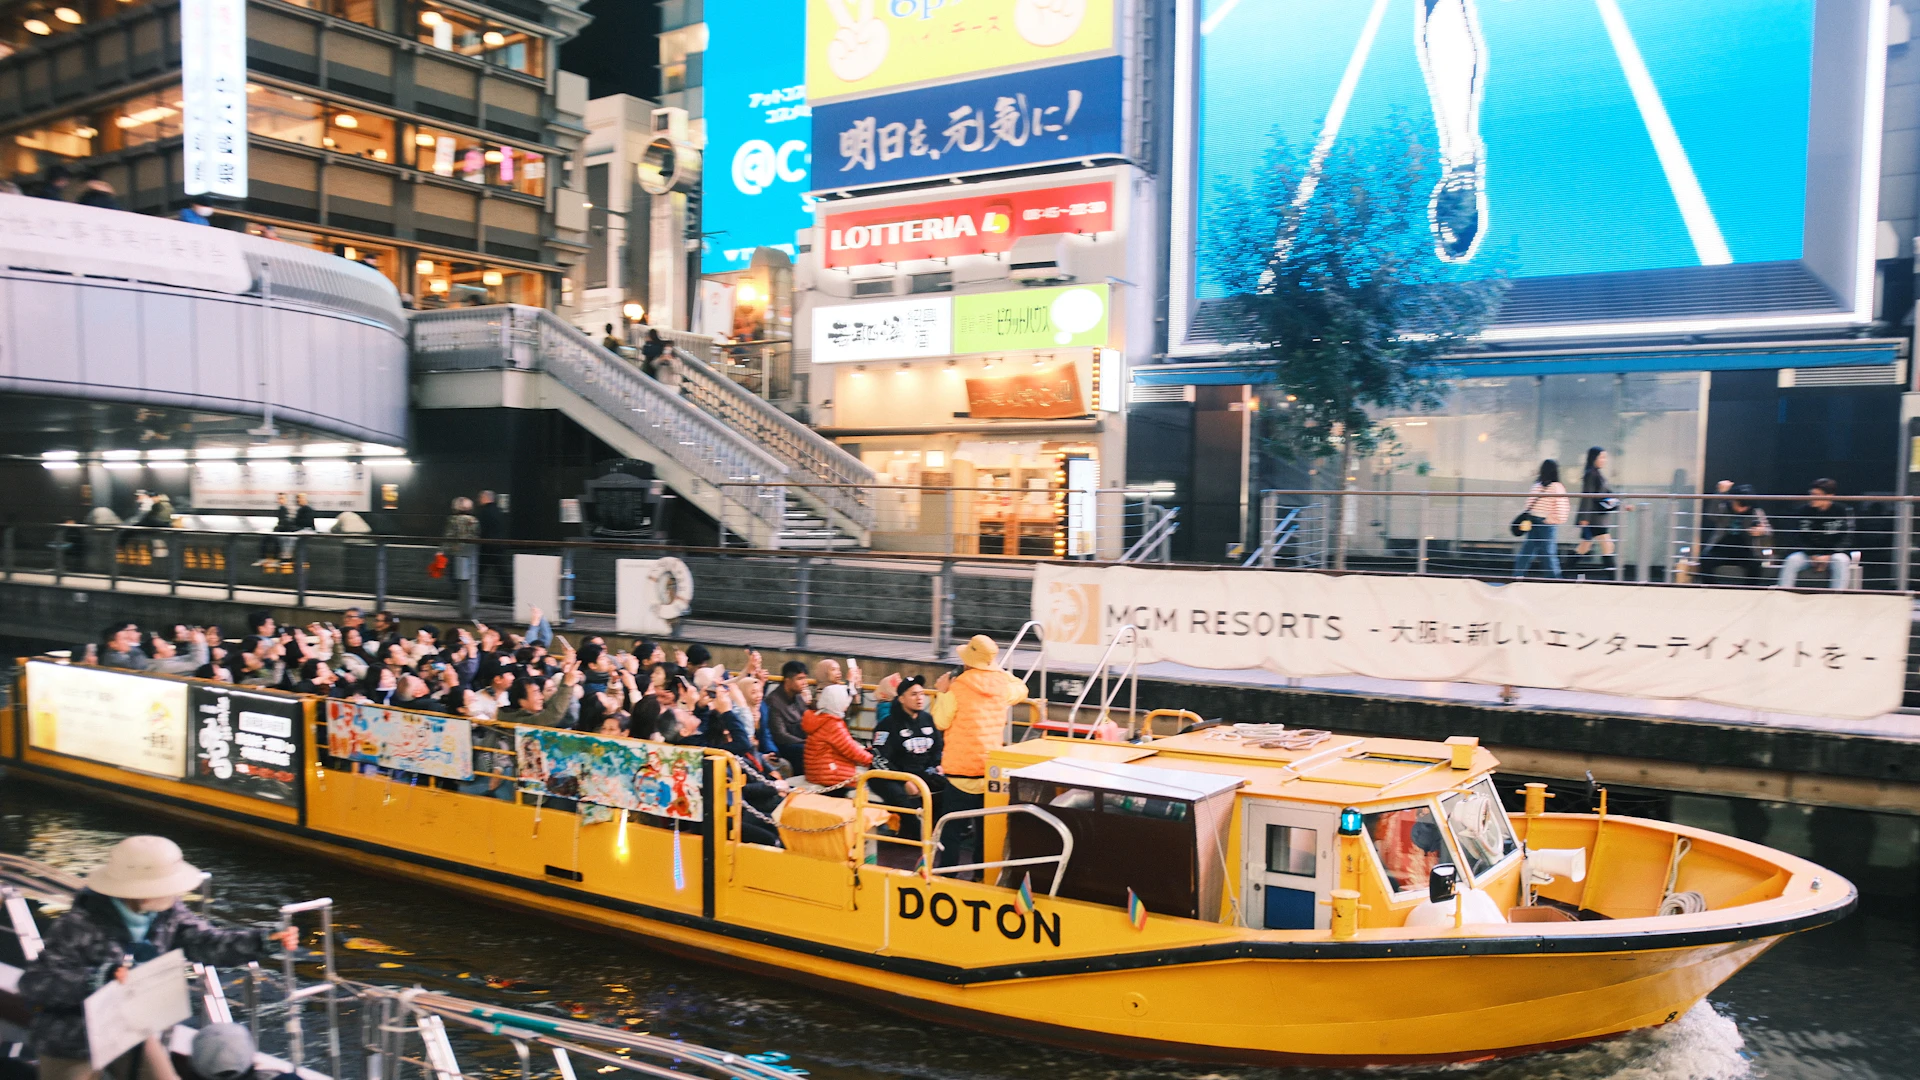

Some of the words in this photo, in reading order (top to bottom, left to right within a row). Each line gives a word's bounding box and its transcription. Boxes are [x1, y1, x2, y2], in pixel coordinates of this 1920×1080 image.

[830, 214, 978, 251] LOTTERIA
[1106, 604, 1178, 632] MGM
[1189, 609, 1342, 641] RESORTS
[897, 887, 1061, 947] DOTON
